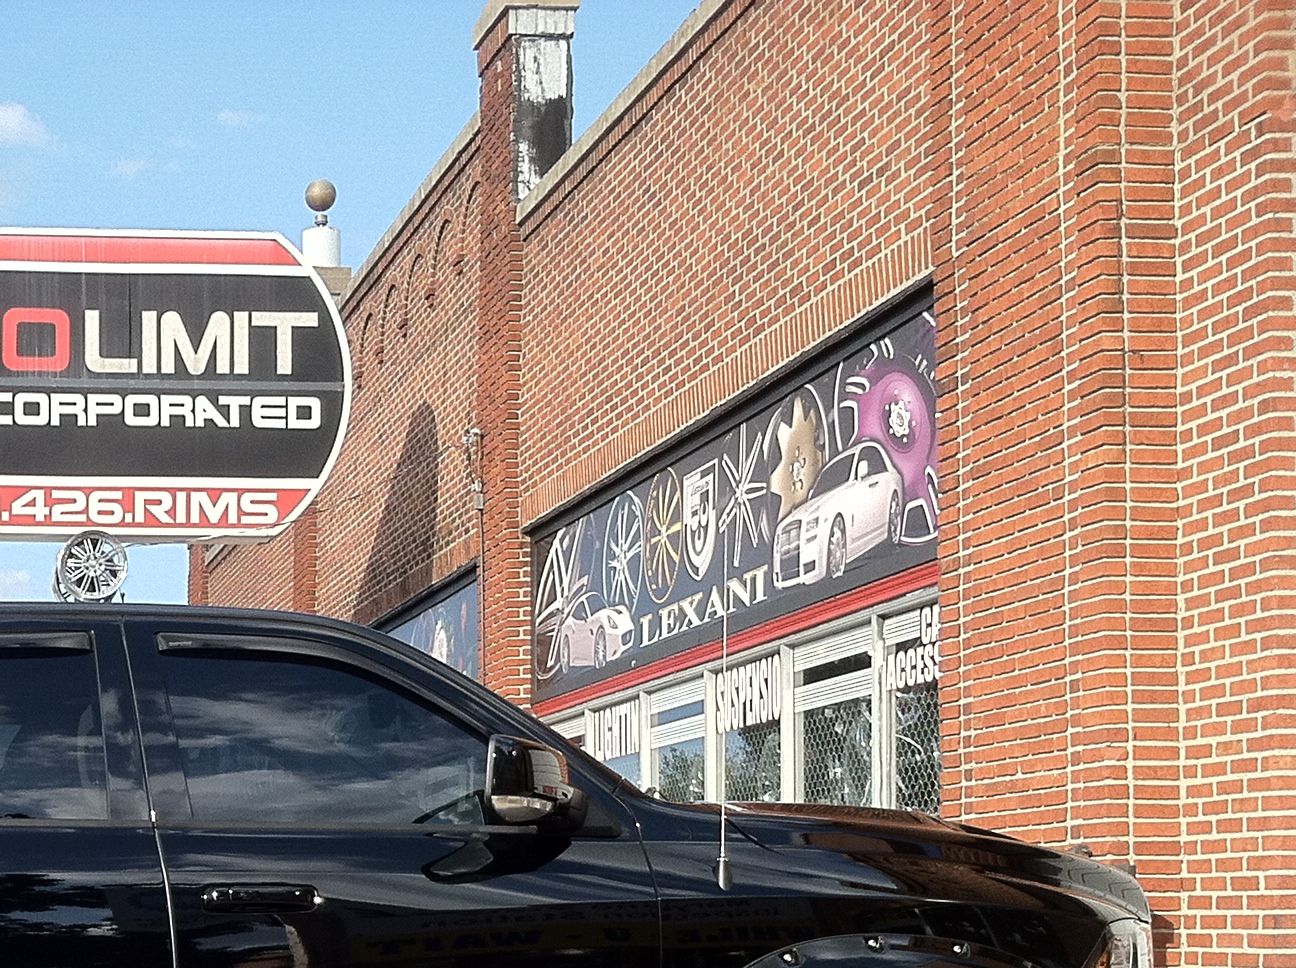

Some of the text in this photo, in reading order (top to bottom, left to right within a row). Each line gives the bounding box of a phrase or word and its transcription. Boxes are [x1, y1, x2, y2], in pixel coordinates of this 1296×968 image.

[84, 308, 319, 376] LIMIT
[639, 564, 769, 648] LEXANI
[716, 653, 781, 735] SUSPENSIO
